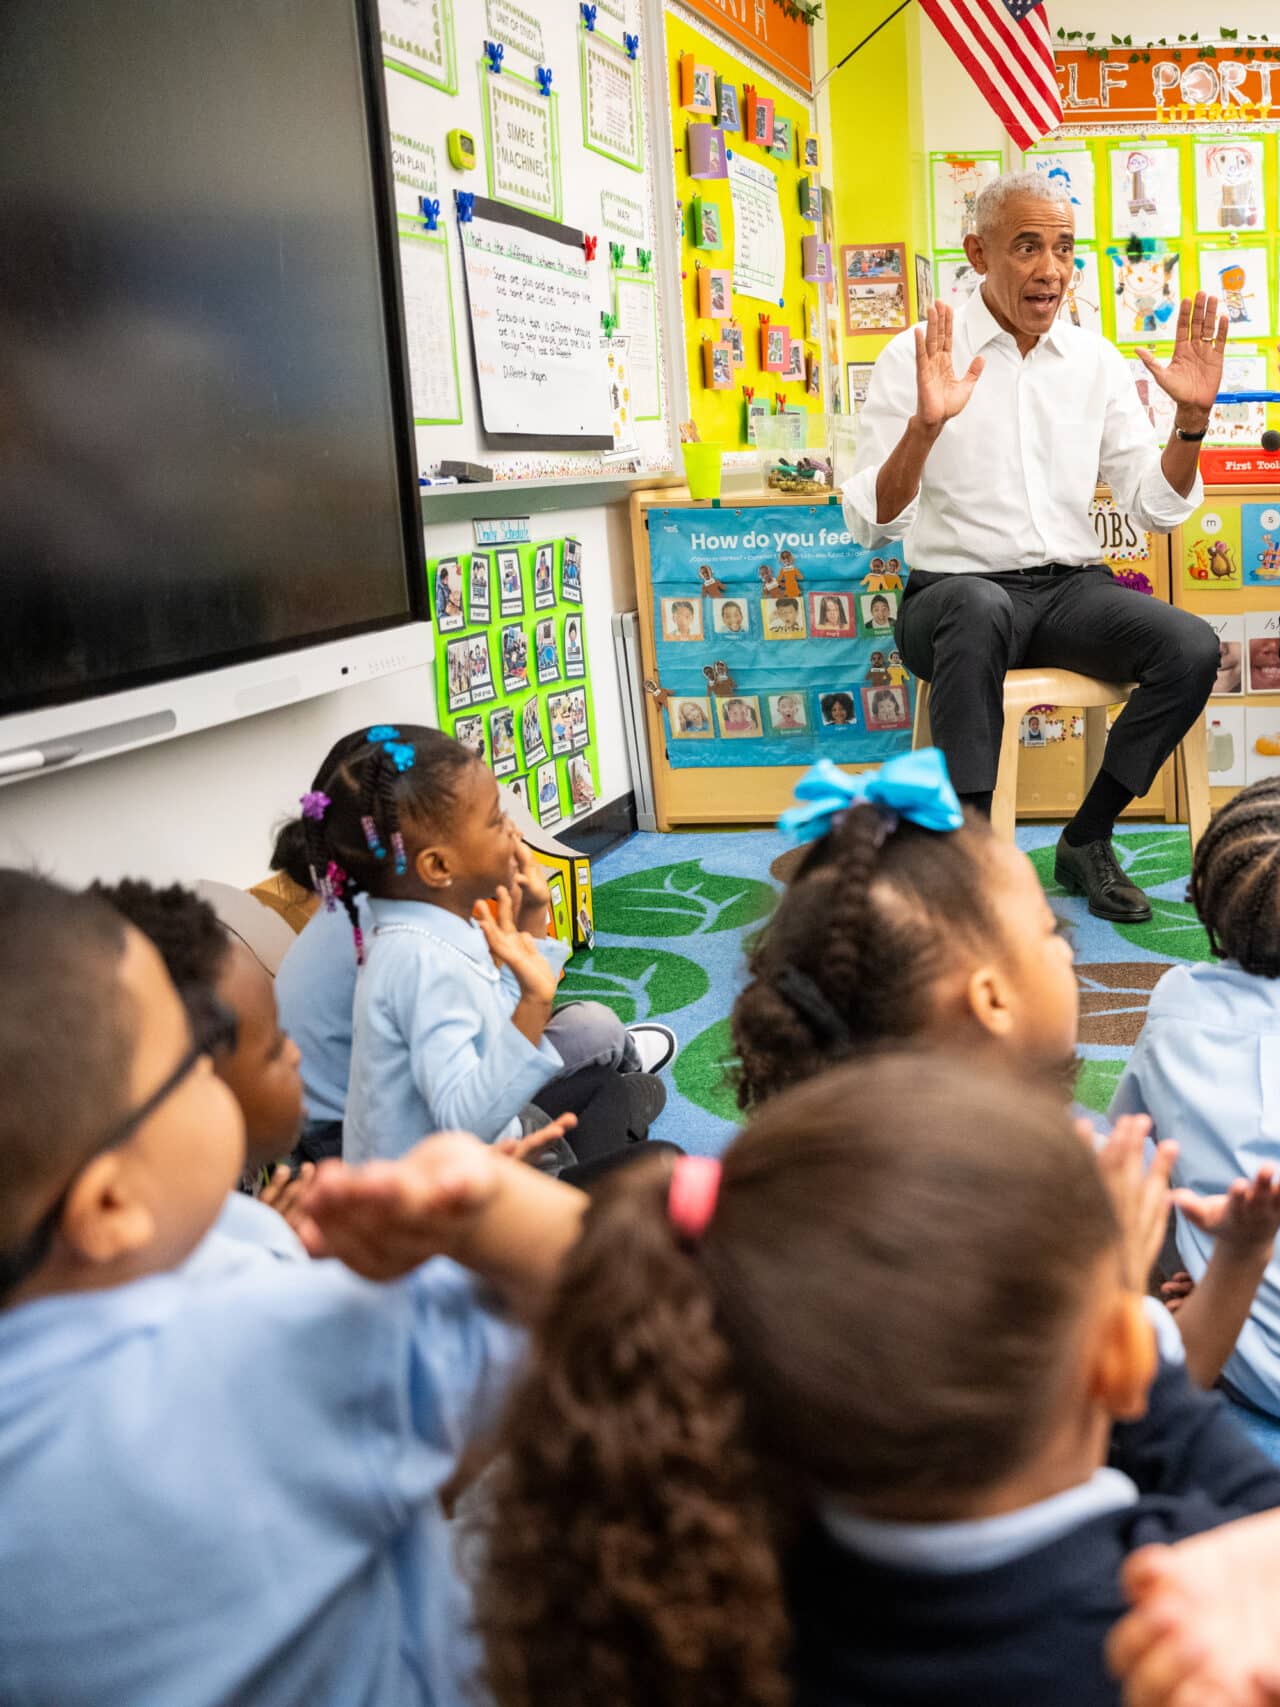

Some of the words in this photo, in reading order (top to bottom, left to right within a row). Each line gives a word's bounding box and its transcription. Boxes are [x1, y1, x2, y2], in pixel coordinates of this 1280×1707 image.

[1156, 102, 1272, 123] LITERACY
[507, 121, 535, 148] SIMPLE
[501, 146, 545, 178] MACHINES
[1224, 461, 1252, 470] First
[476, 520, 497, 543] Daily
[500, 519, 530, 540] Schedule
[1087, 512, 1137, 549] OBS
[1206, 519, 1217, 527] m
[1267, 516, 1274, 524] s
[691, 533, 738, 550] How
[742, 531, 770, 549] do
[773, 531, 814, 553] you
